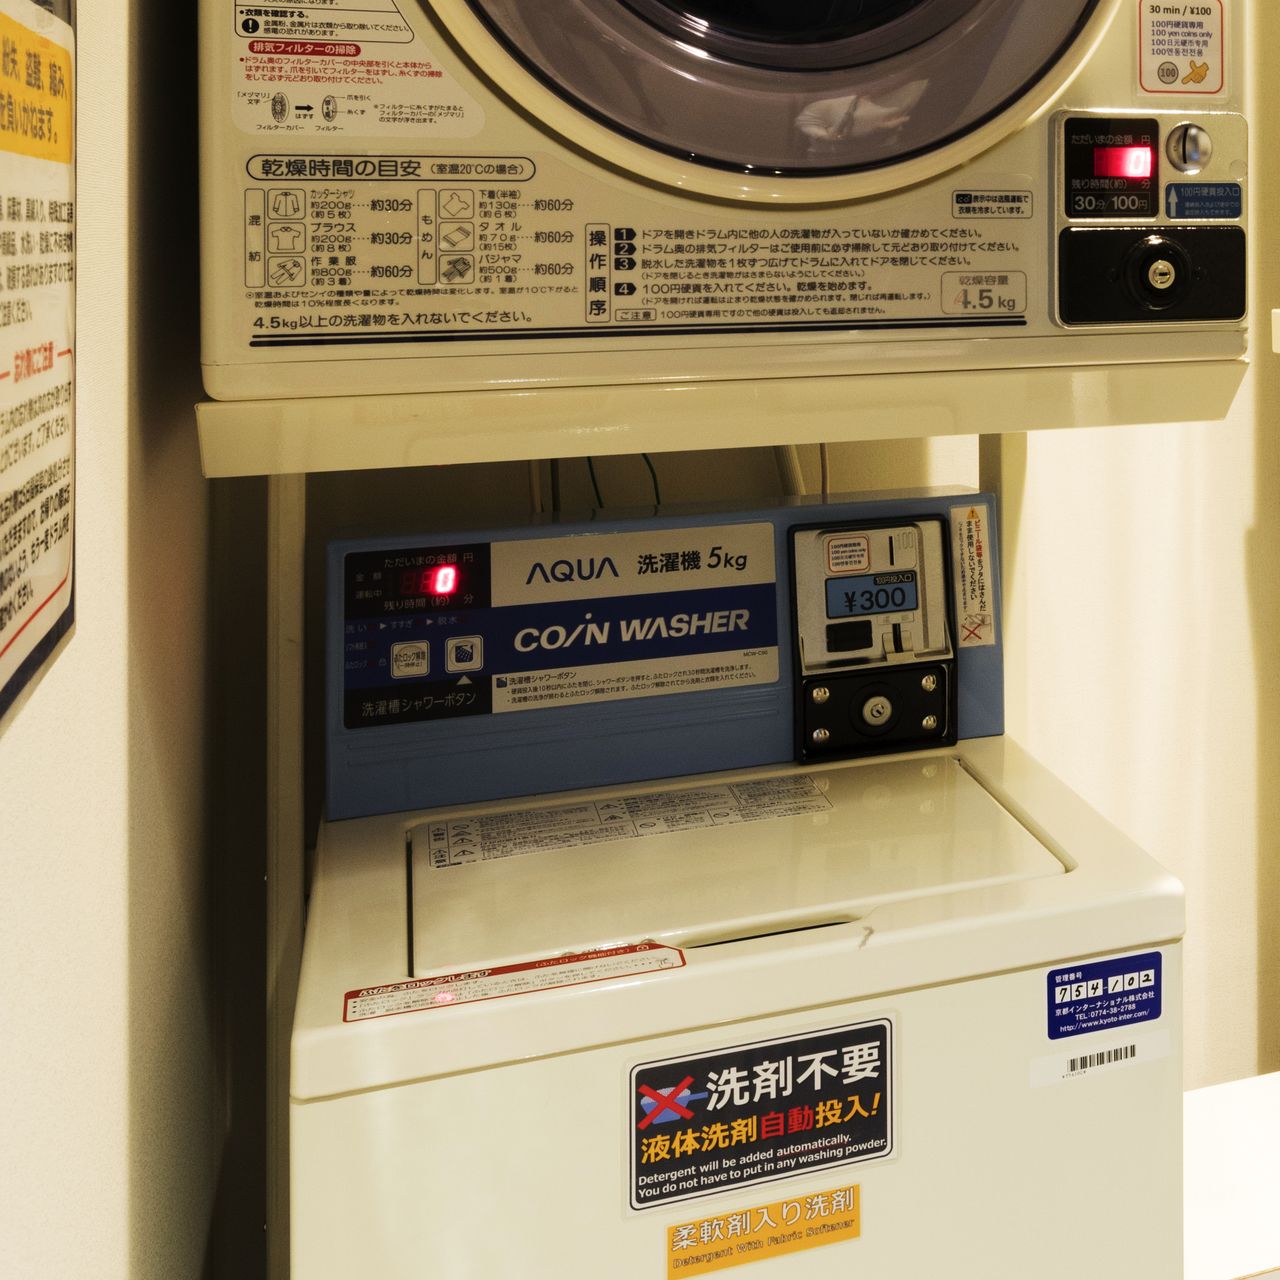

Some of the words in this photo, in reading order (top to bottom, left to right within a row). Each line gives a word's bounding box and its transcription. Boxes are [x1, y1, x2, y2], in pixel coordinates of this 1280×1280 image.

[1149, 5, 1160, 14] 30
[1163, 5, 1180, 15] min
[1190, 6, 1212, 16] ¥100
[1151, 28, 1166, 36] 100
[1168, 30, 1177, 38] yen
[1199, 31, 1213, 39] only
[253, 42, 357, 55] 排気フィルターの掃除
[261, 159, 422, 178] 乾燥時間の目安
[371, 198, 413, 212] 約30分
[535, 198, 574, 211] 約60分
[311, 223, 356, 233] ブラウス
[371, 232, 413, 245] 約30分
[535, 231, 574, 243] 約60分
[371, 265, 413, 278] 約60分
[535, 264, 574, 276] 約60分
[589, 231, 607, 316] 操作順序
[998, 296, 1016, 310] kg
[526, 556, 619, 585] AQUA
[637, 551, 702, 576] 洗濯機
[707, 546, 748, 571] 5kg
[844, 587, 906, 613] ¥300
[620, 609, 750, 642] WASHER
[1055, 972, 1082, 983] 管理番号
[1055, 991, 1155, 1016] 京都インターナショナル株式会社
[706, 1041, 880, 1111] 洗剤不要
[641, 1092, 880, 1164] 液体洗剤自動投入!
[638, 1166, 696, 1187] Detergent
[700, 1160, 718, 1174] will
[722, 1157, 736, 1168] be
[740, 1150, 773, 1166] added
[777, 1134, 851, 1157] automatically.
[639, 1186, 660, 1198] You
[662, 1182, 676, 1194] do
[679, 1178, 698, 1190] not
[700, 1172, 728, 1187] have
[730, 1168, 741, 1180] to
[743, 1164, 762, 1179] put
[764, 1162, 774, 1173] in
[776, 1158, 796, 1172] any
[799, 1147, 843, 1167] washing
[846, 1137, 886, 1159] powder.
[672, 1188, 854, 1251] 柔軟剤入り洗剤
[673, 1248, 732, 1269] Detergent
[736, 1239, 763, 1255] With
[768, 1230, 802, 1248] Fabric
[806, 1218, 854, 1238] Softener
